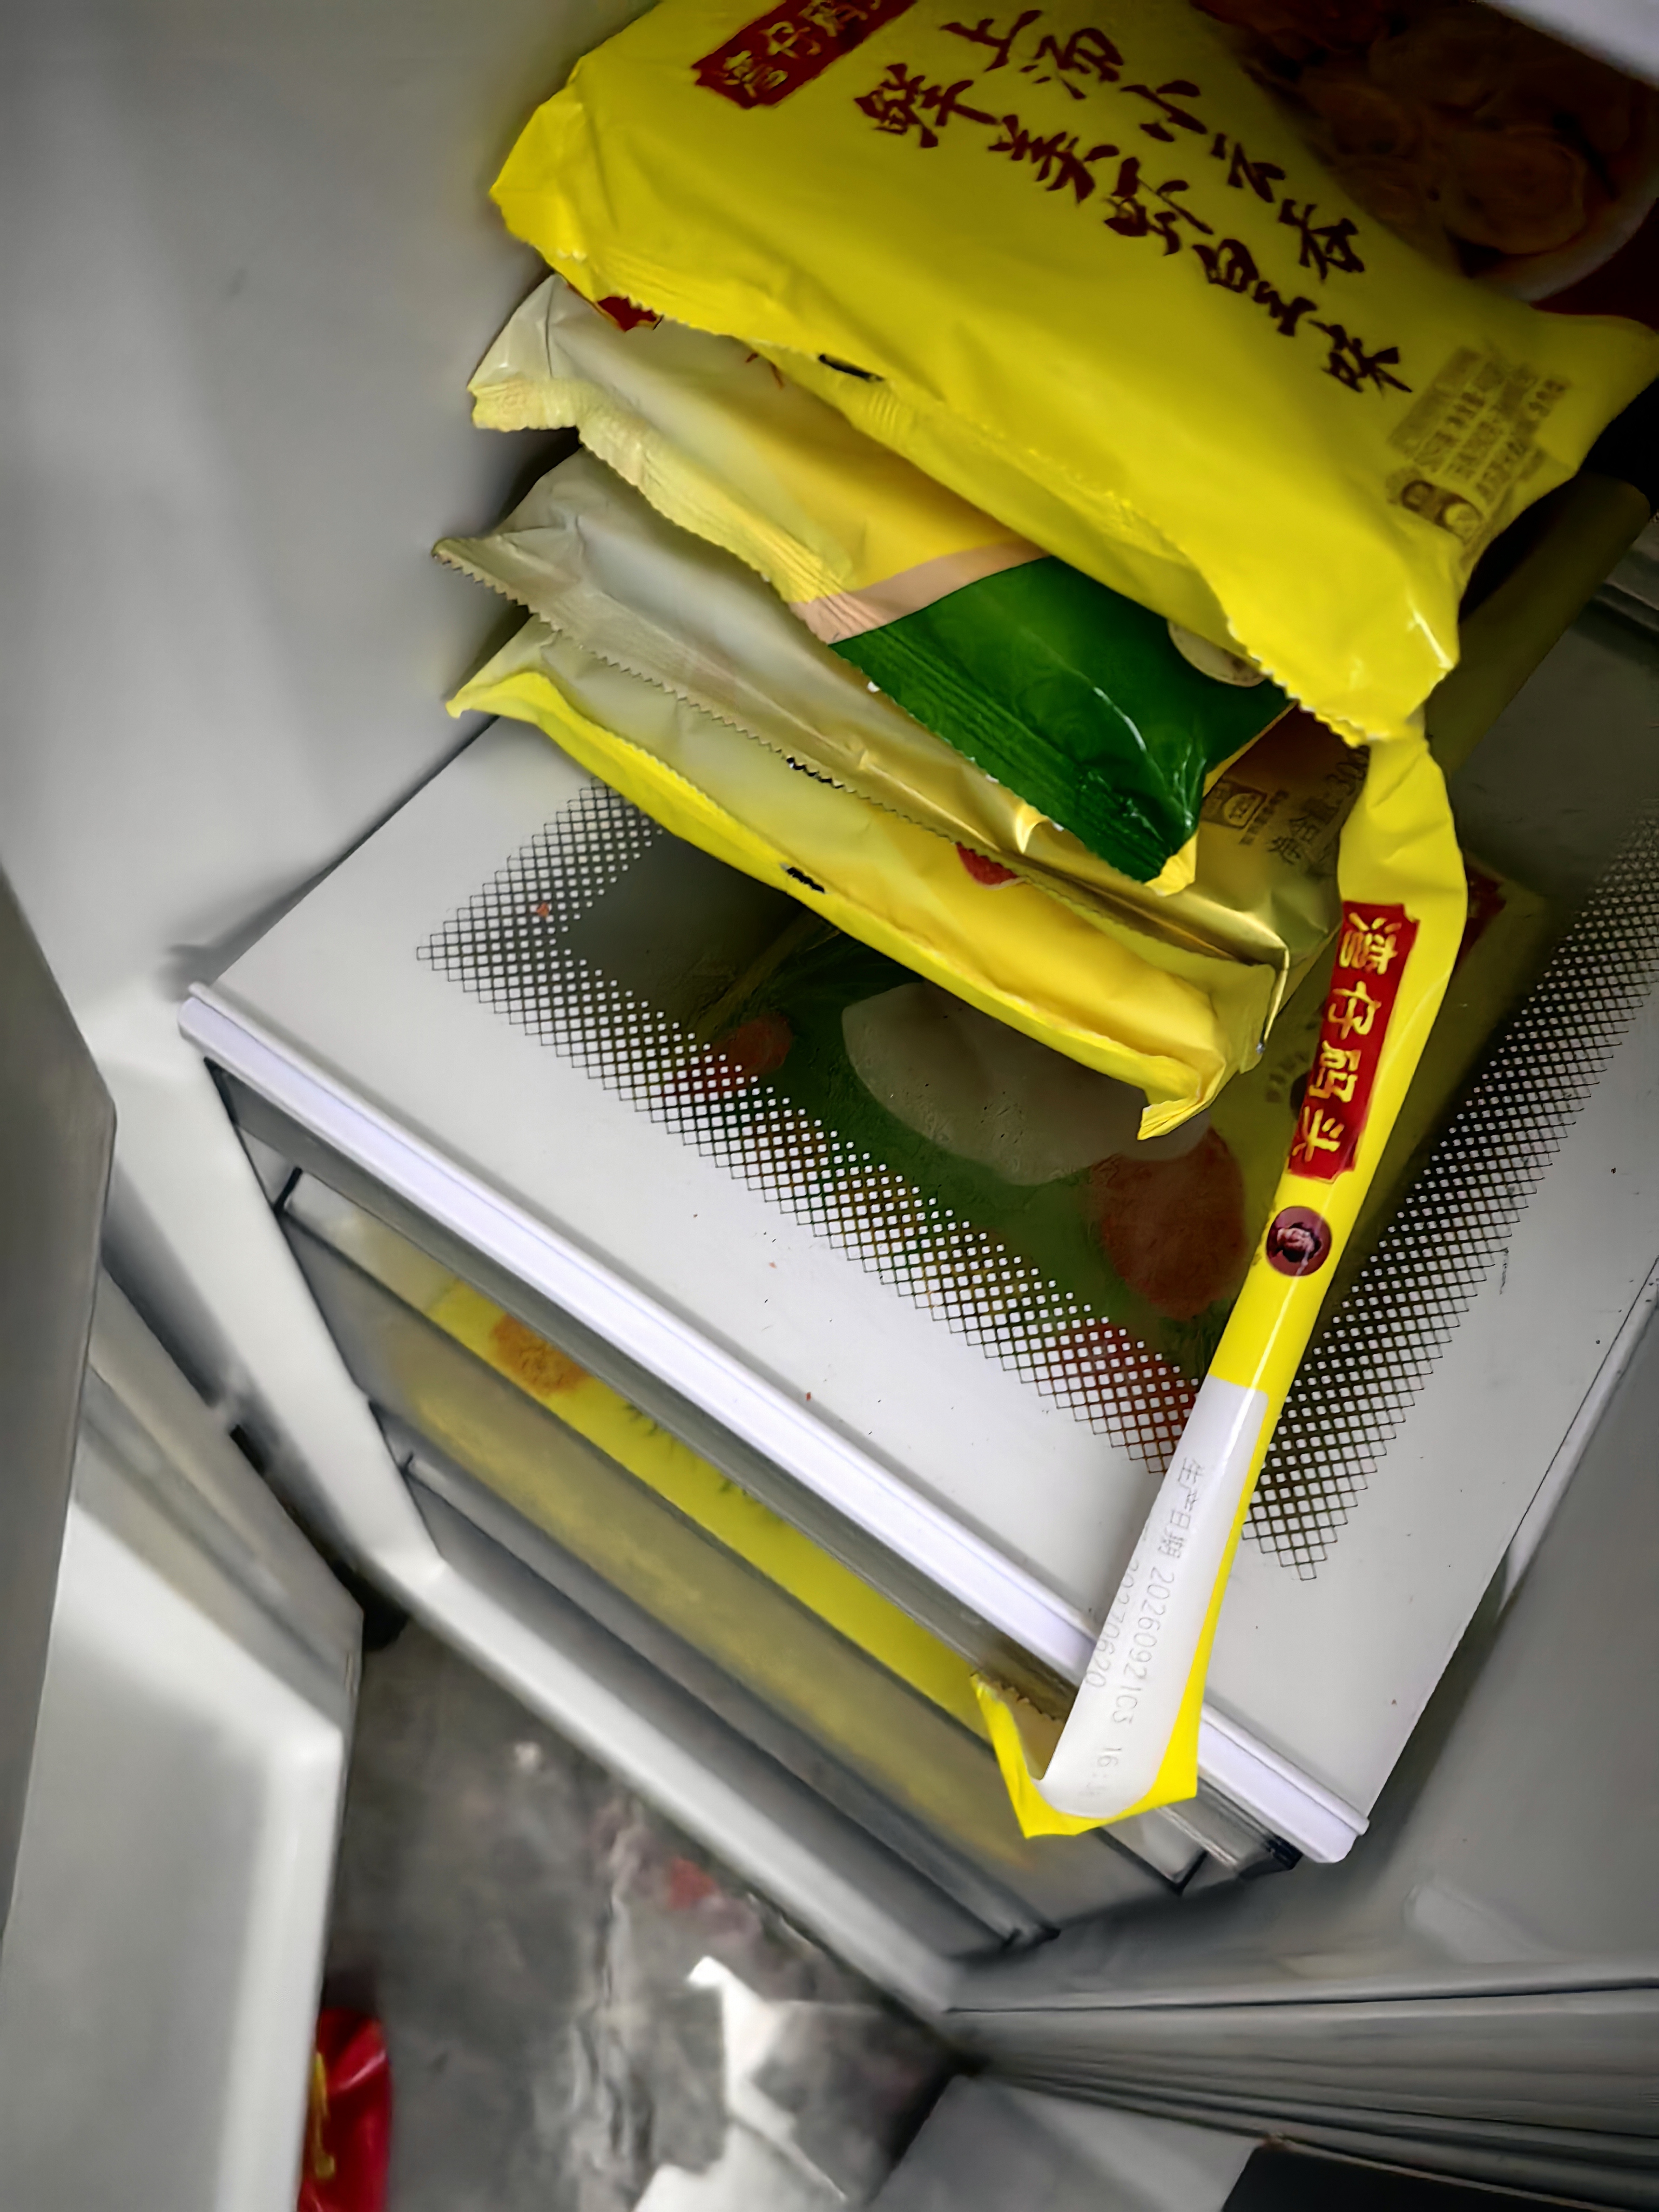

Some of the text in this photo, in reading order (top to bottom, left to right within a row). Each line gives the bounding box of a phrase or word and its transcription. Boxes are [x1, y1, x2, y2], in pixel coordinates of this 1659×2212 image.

[721, 0, 881, 96] 湾仔码
[940, 9, 1365, 280] 上汤小云吞
[853, 63, 1413, 394] 鲜美虾皇味
[1291, 912, 1402, 1163] 湾仔码头
[1157, 1456, 1205, 1559] 生产日期
